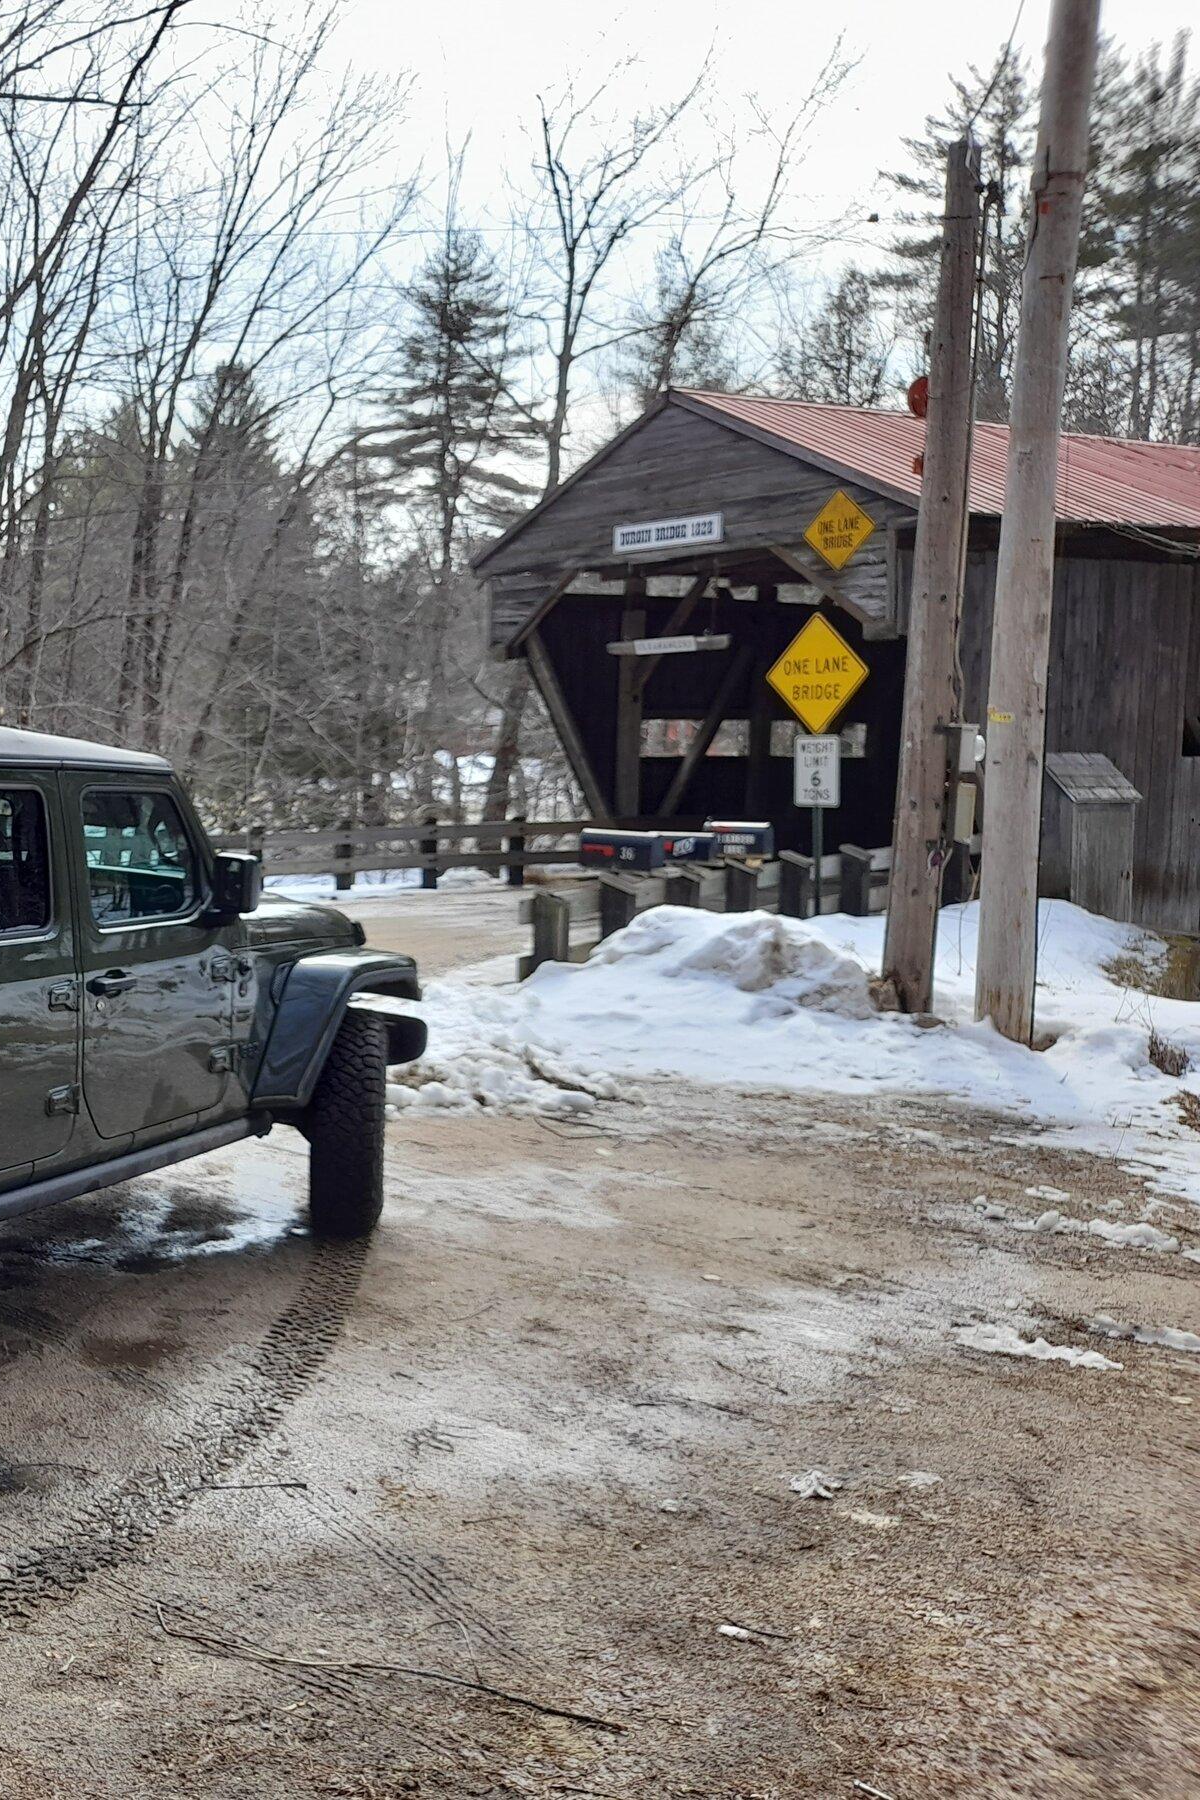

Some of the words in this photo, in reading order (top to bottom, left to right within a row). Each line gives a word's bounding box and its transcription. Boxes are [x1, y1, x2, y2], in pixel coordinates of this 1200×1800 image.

[655, 524, 687, 542] BRIDGE
[817, 520, 834, 536] ONE
[838, 516, 861, 532] LANE
[822, 533, 854, 551] BRIDGE
[784, 658, 810, 676] ONE
[815, 656, 849, 674] LANE
[792, 683, 841, 701] BRIDGE
[801, 742, 834, 754] WEIGHT
[804, 755, 829, 768] LIMIT
[810, 770, 821, 787] 6
[802, 787, 831, 801] TONS
